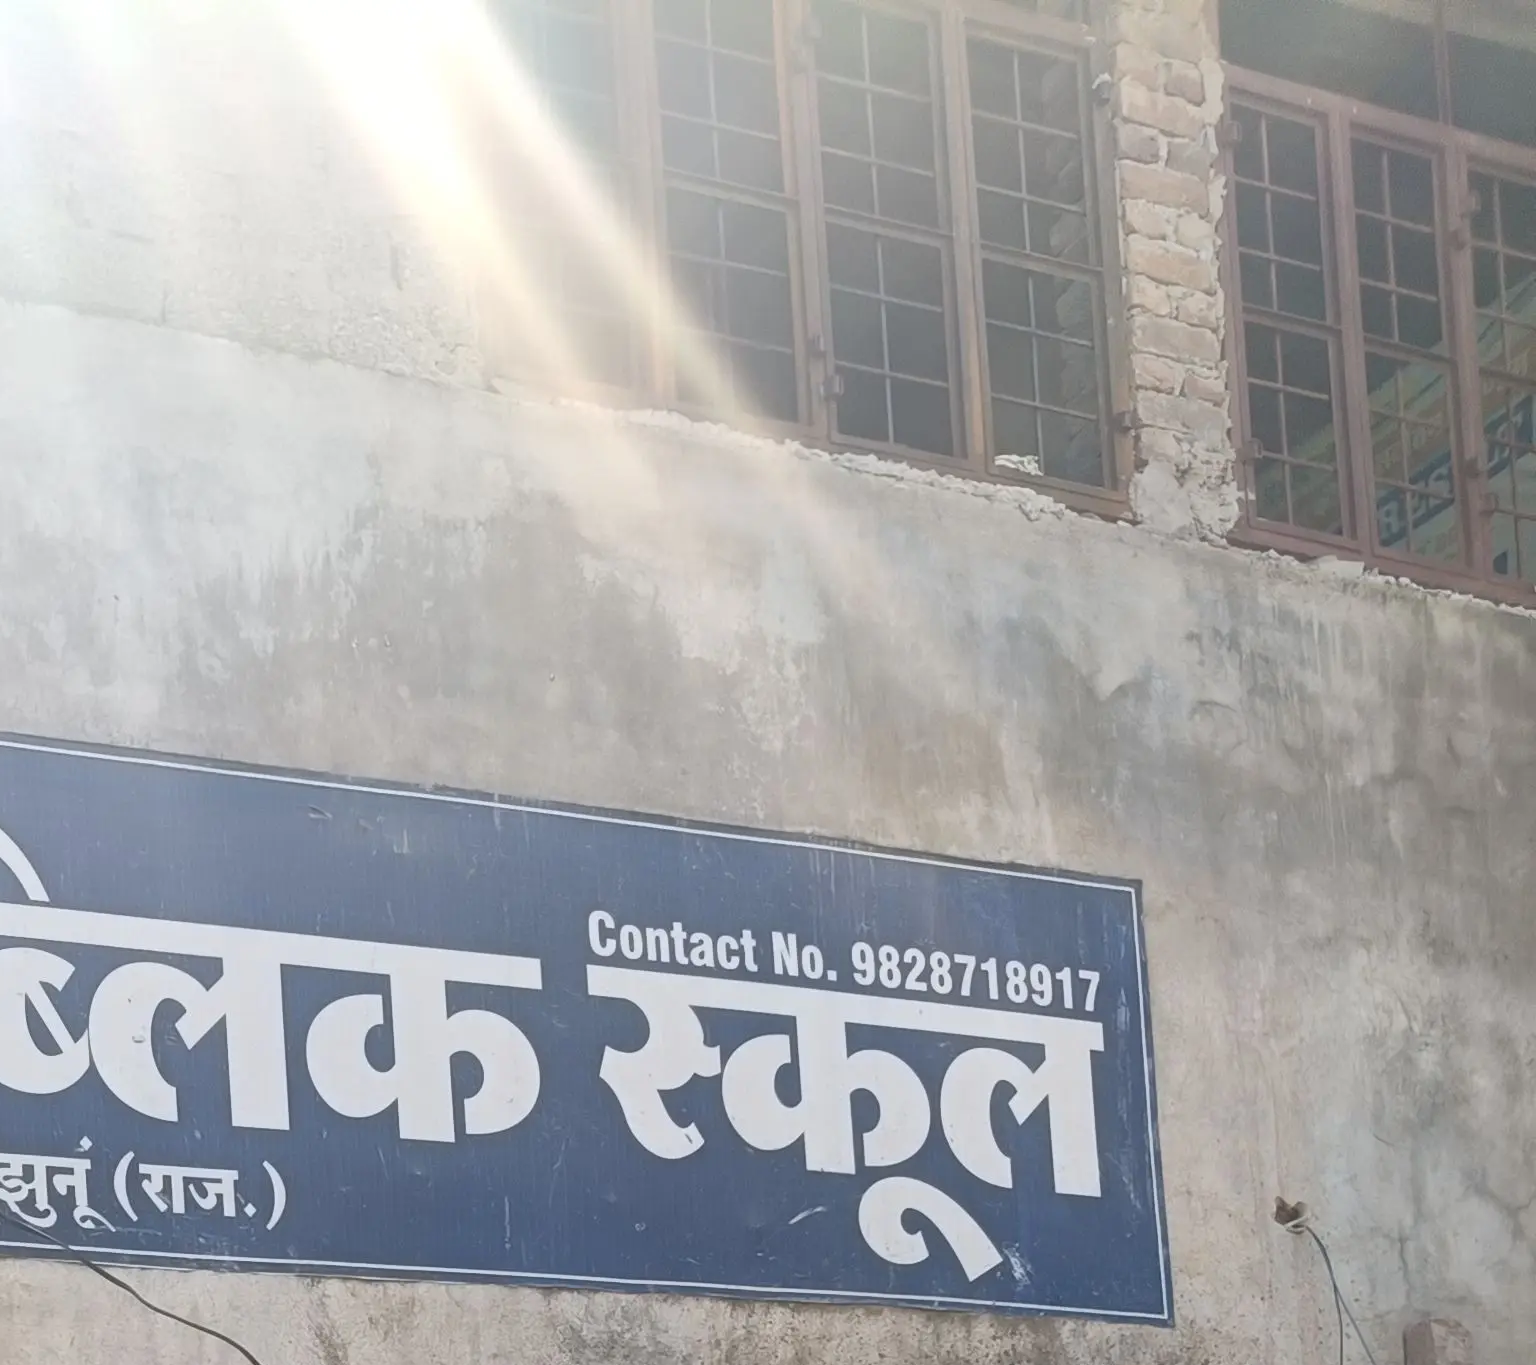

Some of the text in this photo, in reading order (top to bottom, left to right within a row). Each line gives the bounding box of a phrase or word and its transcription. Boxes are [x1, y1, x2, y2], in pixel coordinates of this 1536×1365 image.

[587, 909, 1101, 1012] Contact No. 9828718917
[586, 963, 1104, 1281] स्कूल
[113, 1150, 287, 1231] (राज.)
